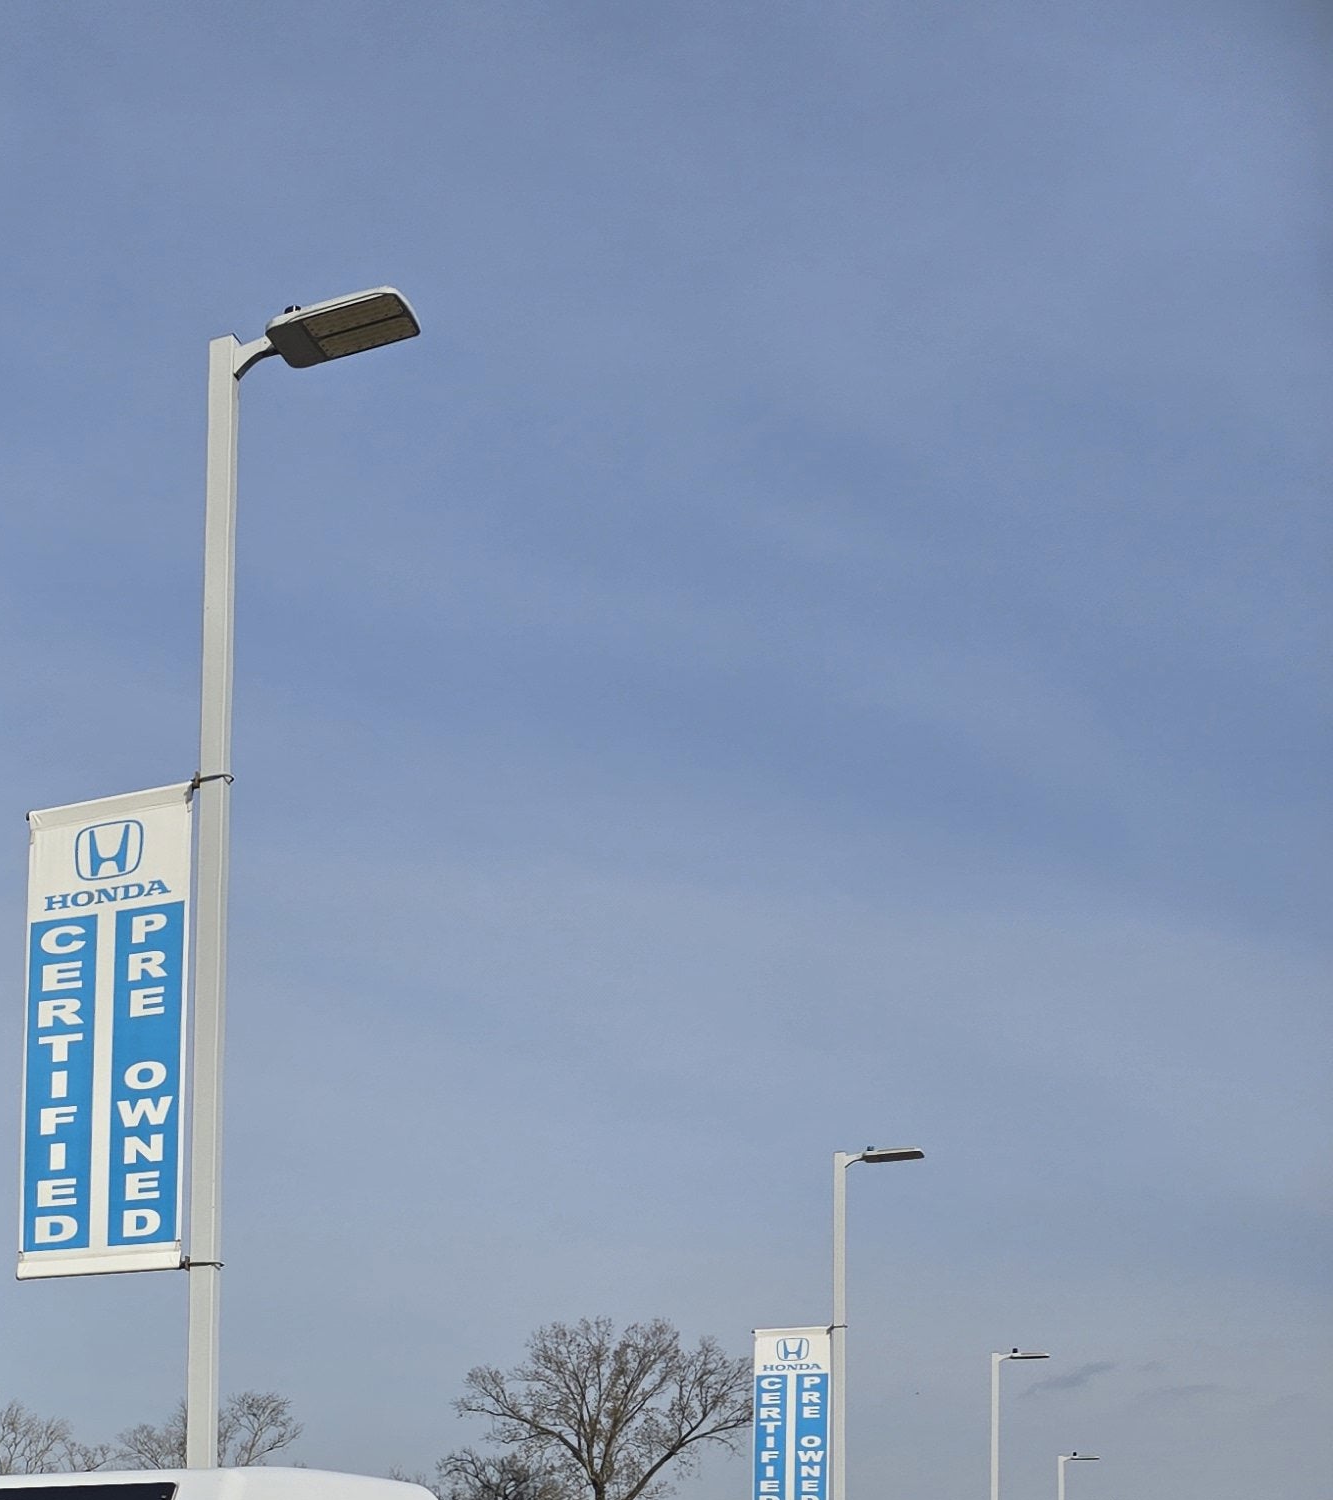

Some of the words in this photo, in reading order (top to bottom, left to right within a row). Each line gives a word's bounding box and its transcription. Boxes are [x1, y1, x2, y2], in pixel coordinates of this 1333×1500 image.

[44, 879, 172, 911] HONDA
[128, 913, 168, 1019] PRE
[34, 924, 87, 1244] CERTIFIED
[117, 1060, 173, 1239] OWNED
[802, 1376, 821, 1418] PRE
